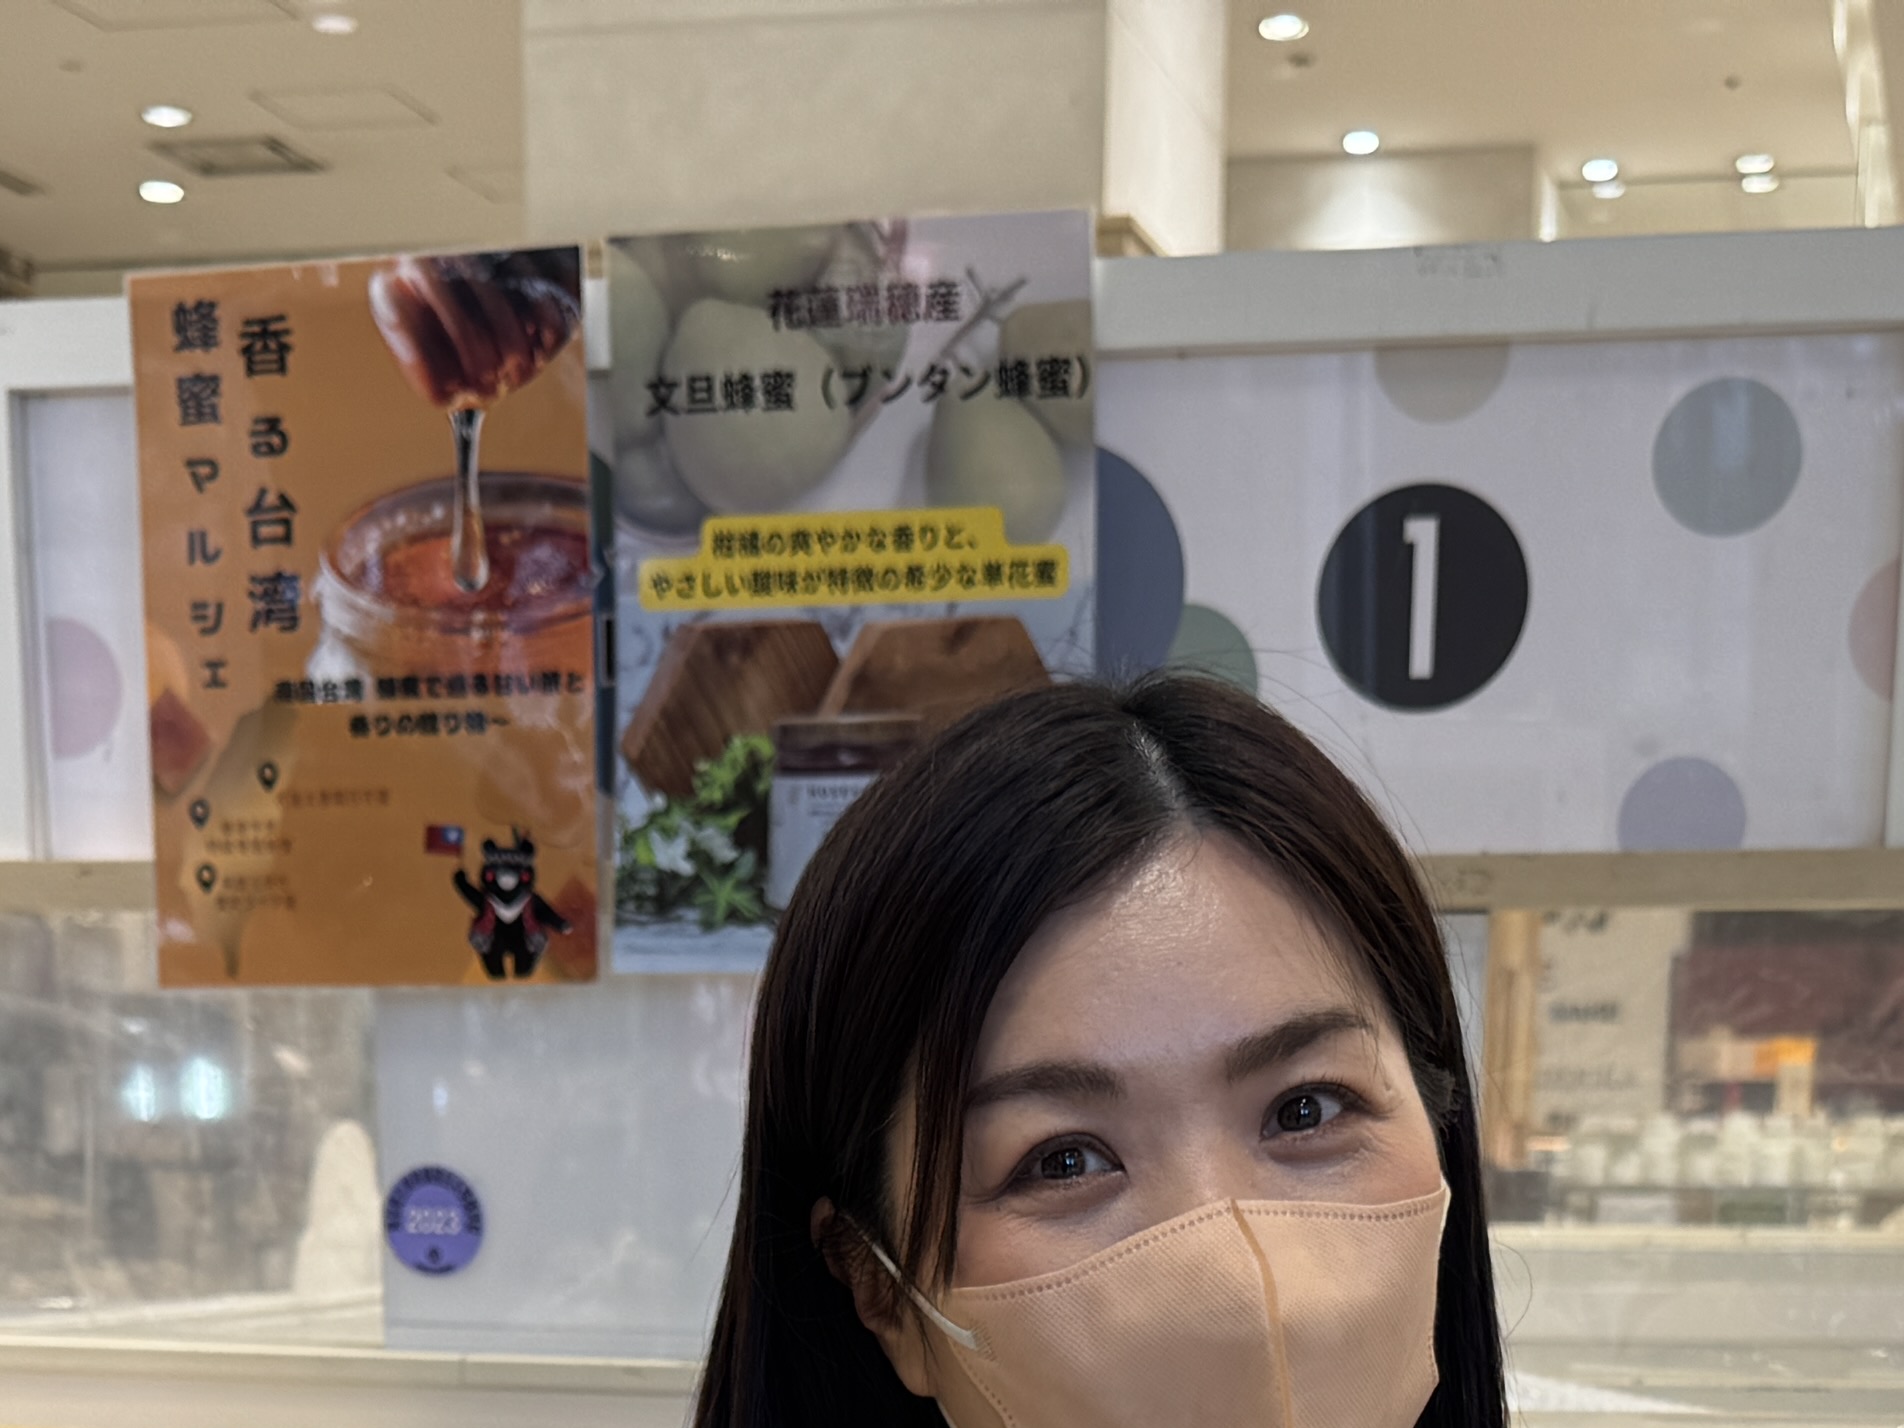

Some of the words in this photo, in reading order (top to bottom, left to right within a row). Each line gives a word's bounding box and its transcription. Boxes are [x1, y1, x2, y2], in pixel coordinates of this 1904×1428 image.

[170, 299, 228, 692] 蜂蜜マルシェ
[237, 312, 304, 636] 香る台湾
[1403, 515, 1440, 679] 1
